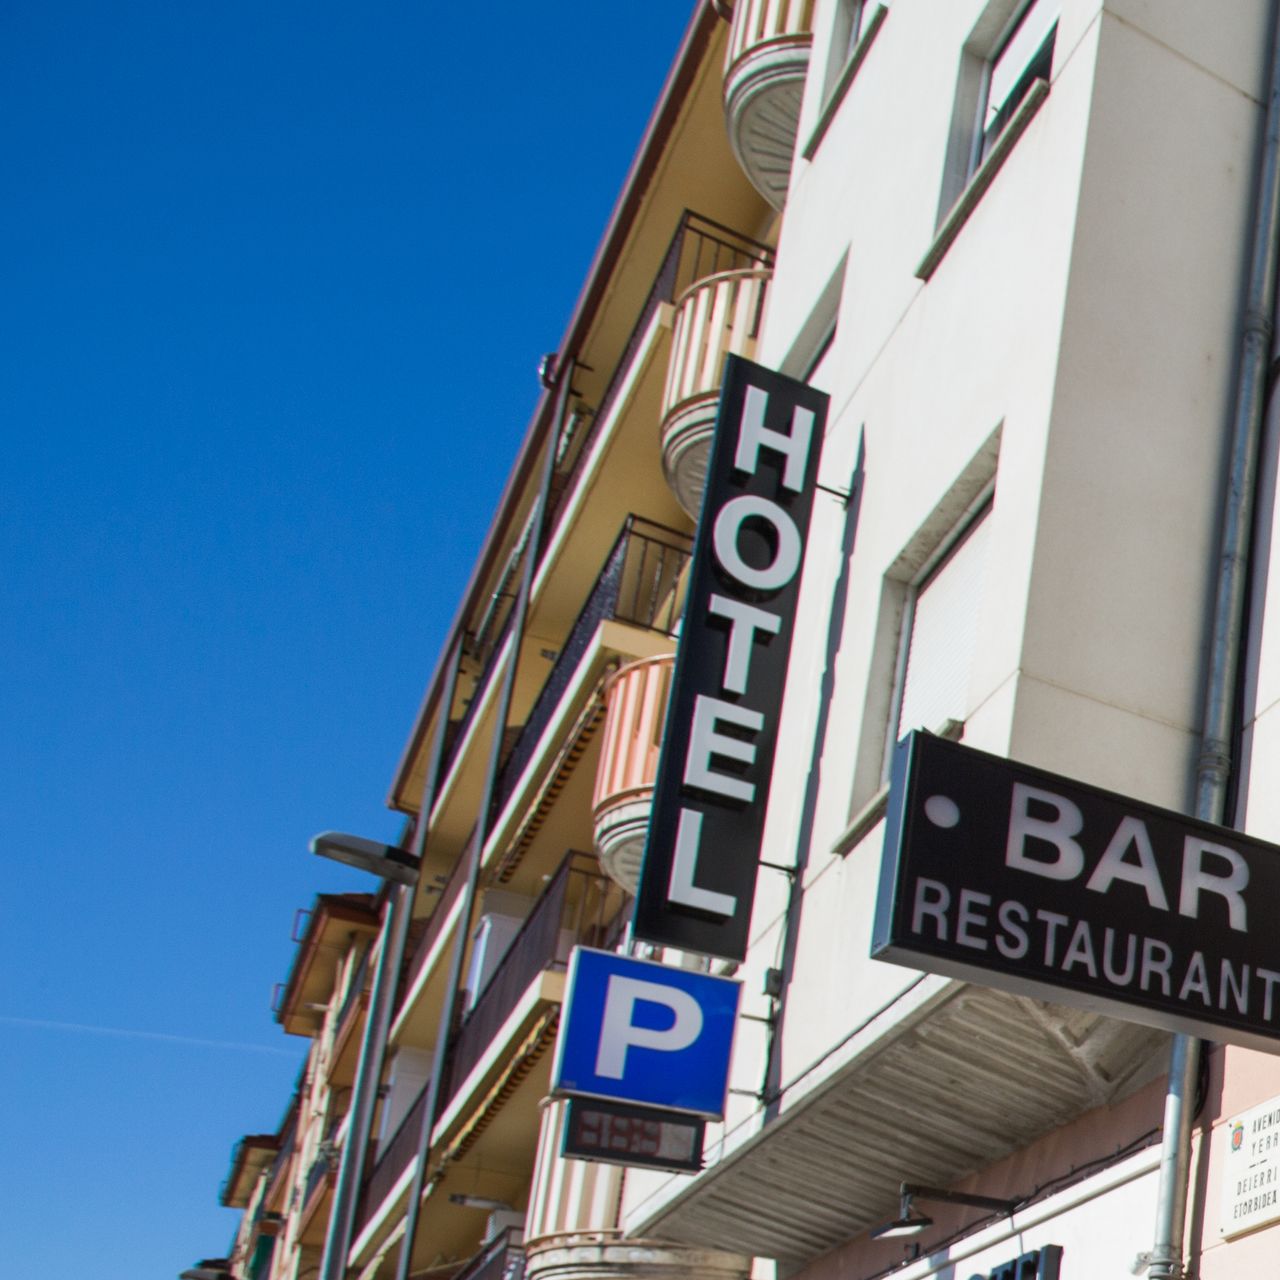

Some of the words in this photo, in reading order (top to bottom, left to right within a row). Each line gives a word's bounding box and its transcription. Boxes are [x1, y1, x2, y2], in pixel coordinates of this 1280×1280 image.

[667, 384, 816, 917] HOTEL
[1005, 782, 1250, 933] BAR
[594, 973, 704, 1080] P
[1233, 1190, 1277, 1219] ETORBIDEA
[1237, 1166, 1278, 1196] DEIERRI
